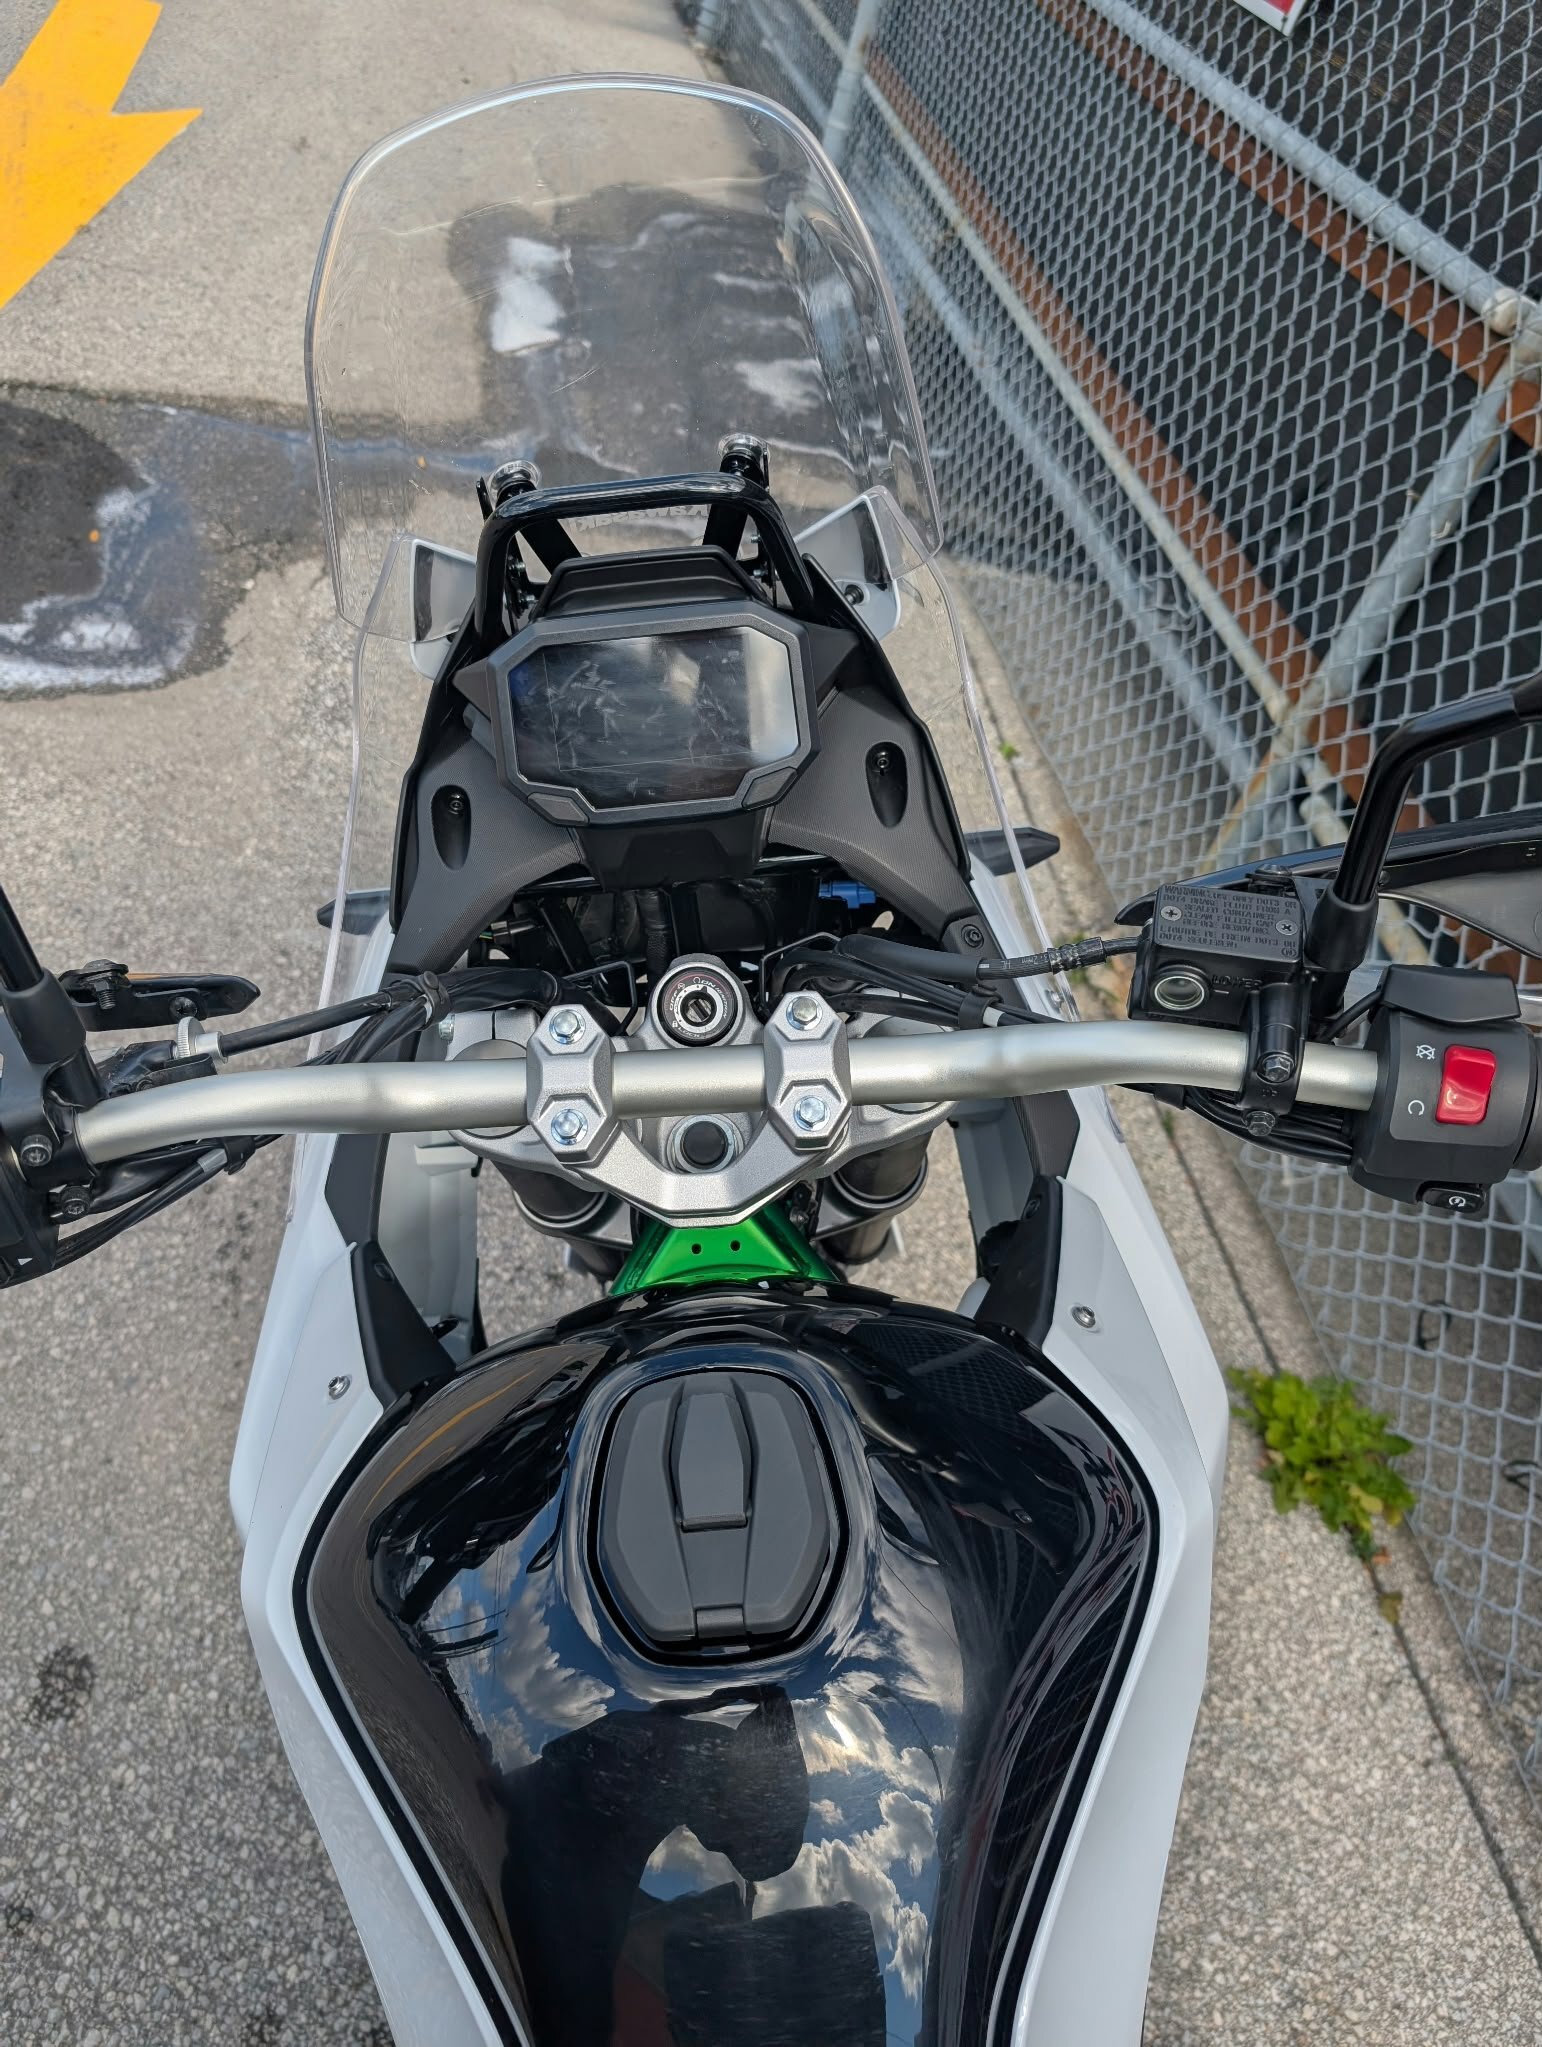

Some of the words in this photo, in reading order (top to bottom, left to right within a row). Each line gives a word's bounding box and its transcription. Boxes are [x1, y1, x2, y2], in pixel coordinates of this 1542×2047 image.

[701, 980, 716, 988] ON
[669, 990, 678, 1011] OFF
[678, 1027, 700, 1037] LOCK
